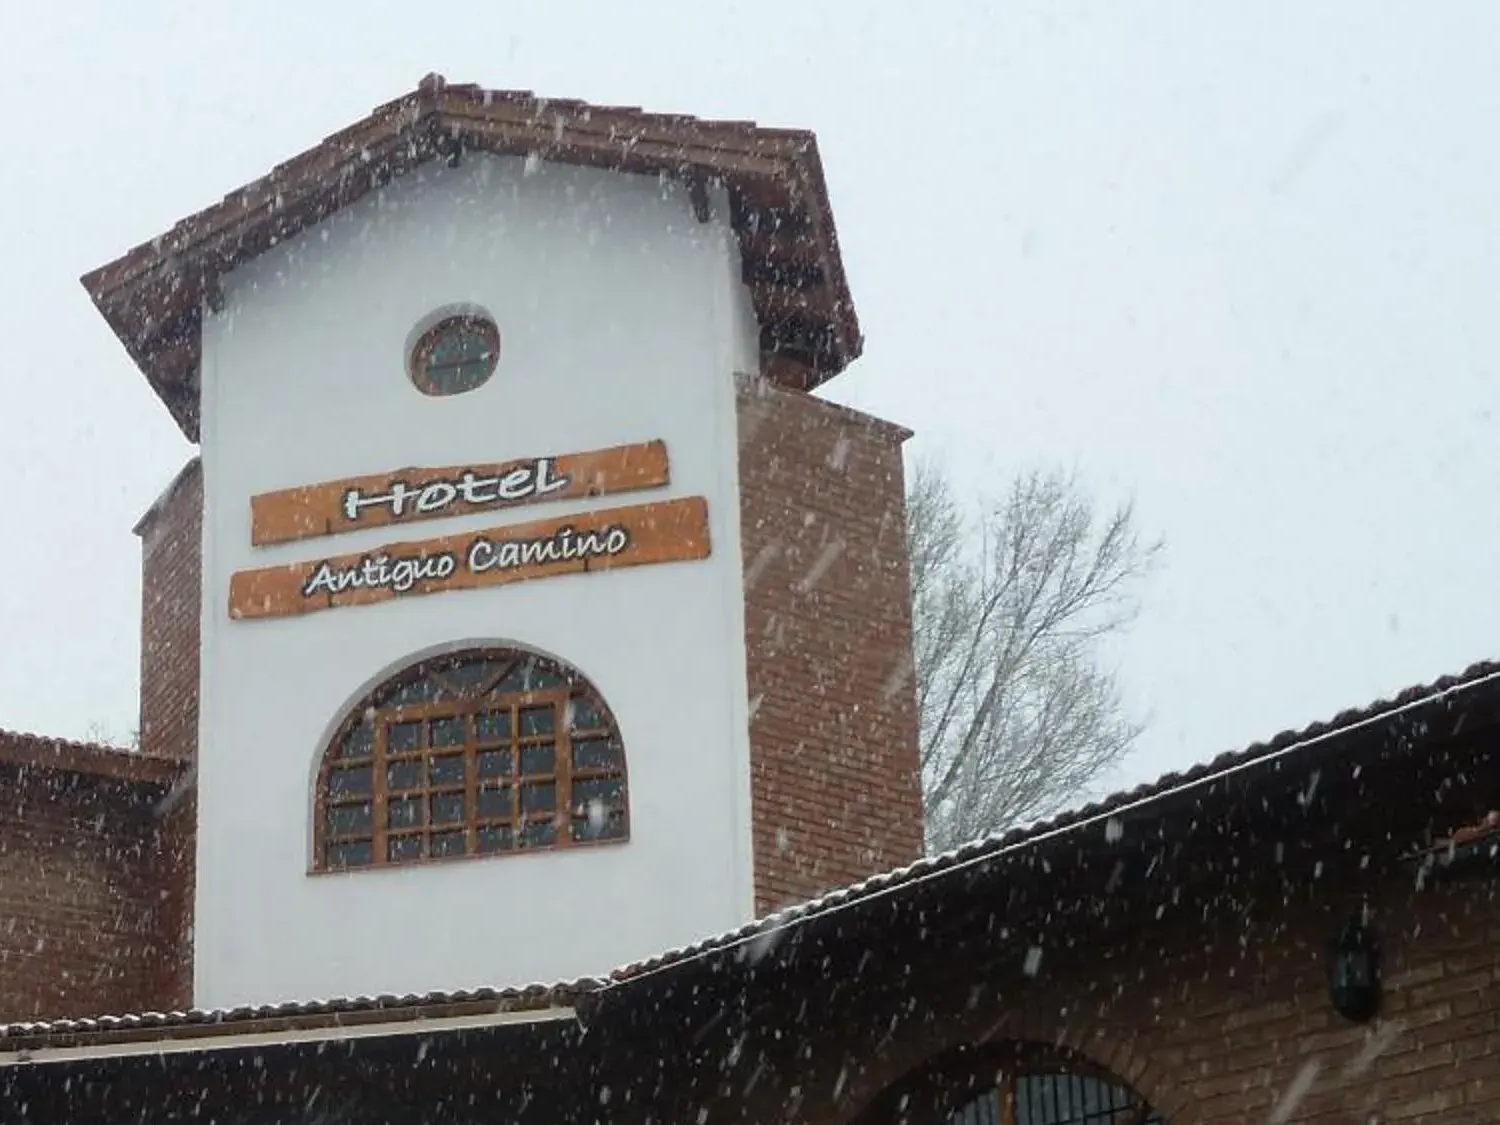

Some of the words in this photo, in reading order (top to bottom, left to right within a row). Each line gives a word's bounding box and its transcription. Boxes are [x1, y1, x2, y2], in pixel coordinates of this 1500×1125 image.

[344, 459, 566, 519] Hotel
[305, 555, 454, 595] Antiguo
[468, 527, 626, 572] Camino
